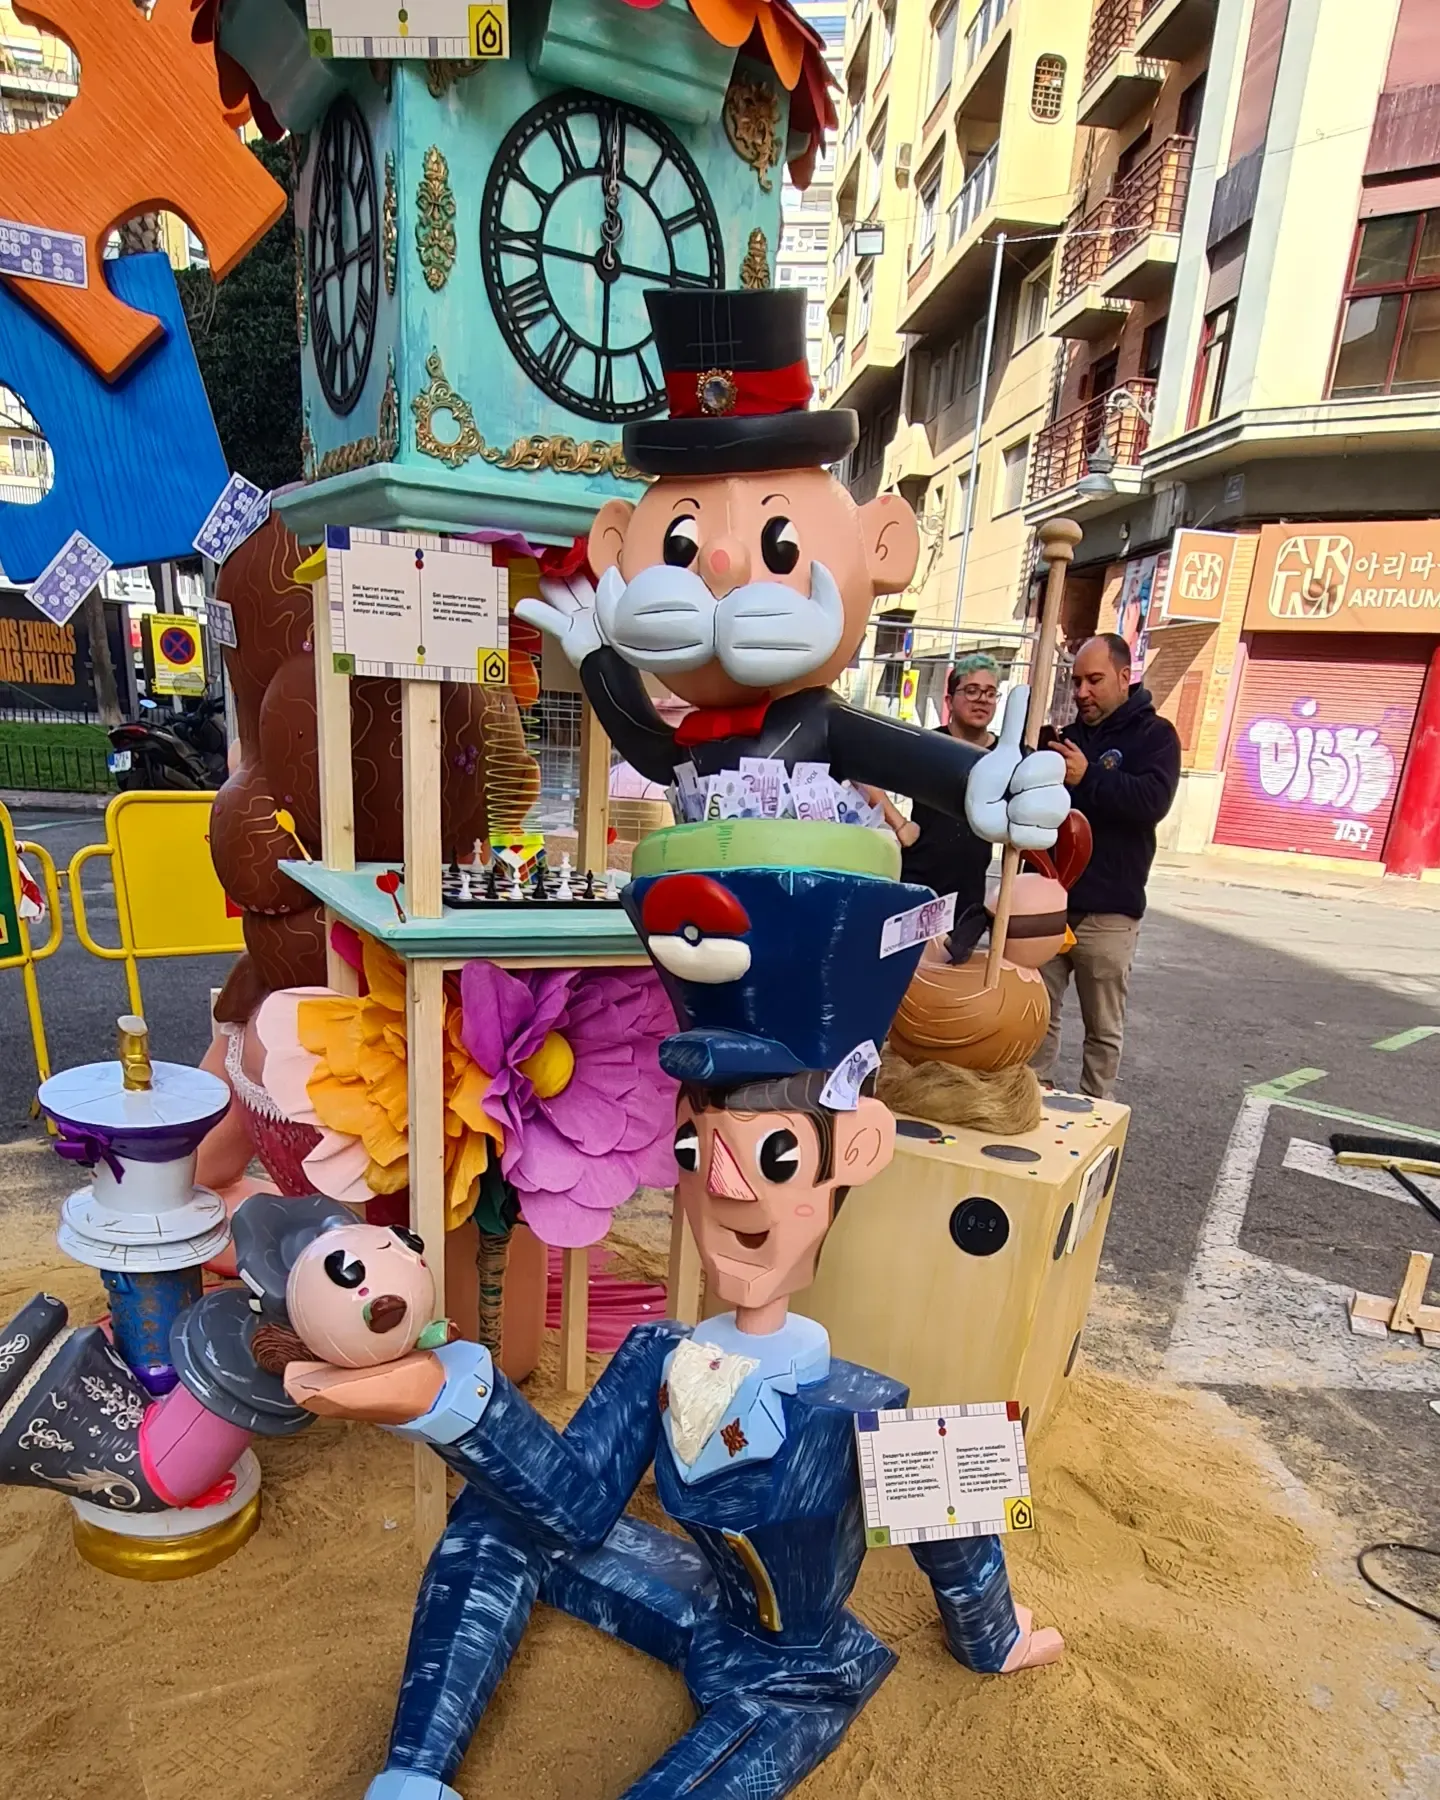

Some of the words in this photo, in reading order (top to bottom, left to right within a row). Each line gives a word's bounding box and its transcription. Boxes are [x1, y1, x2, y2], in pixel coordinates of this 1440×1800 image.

[1355, 551, 1440, 581] 아리따
[0, 617, 20, 651] OS
[19, 620, 77, 655] EXCUSAS
[22, 652, 76, 685] PAELLAS
